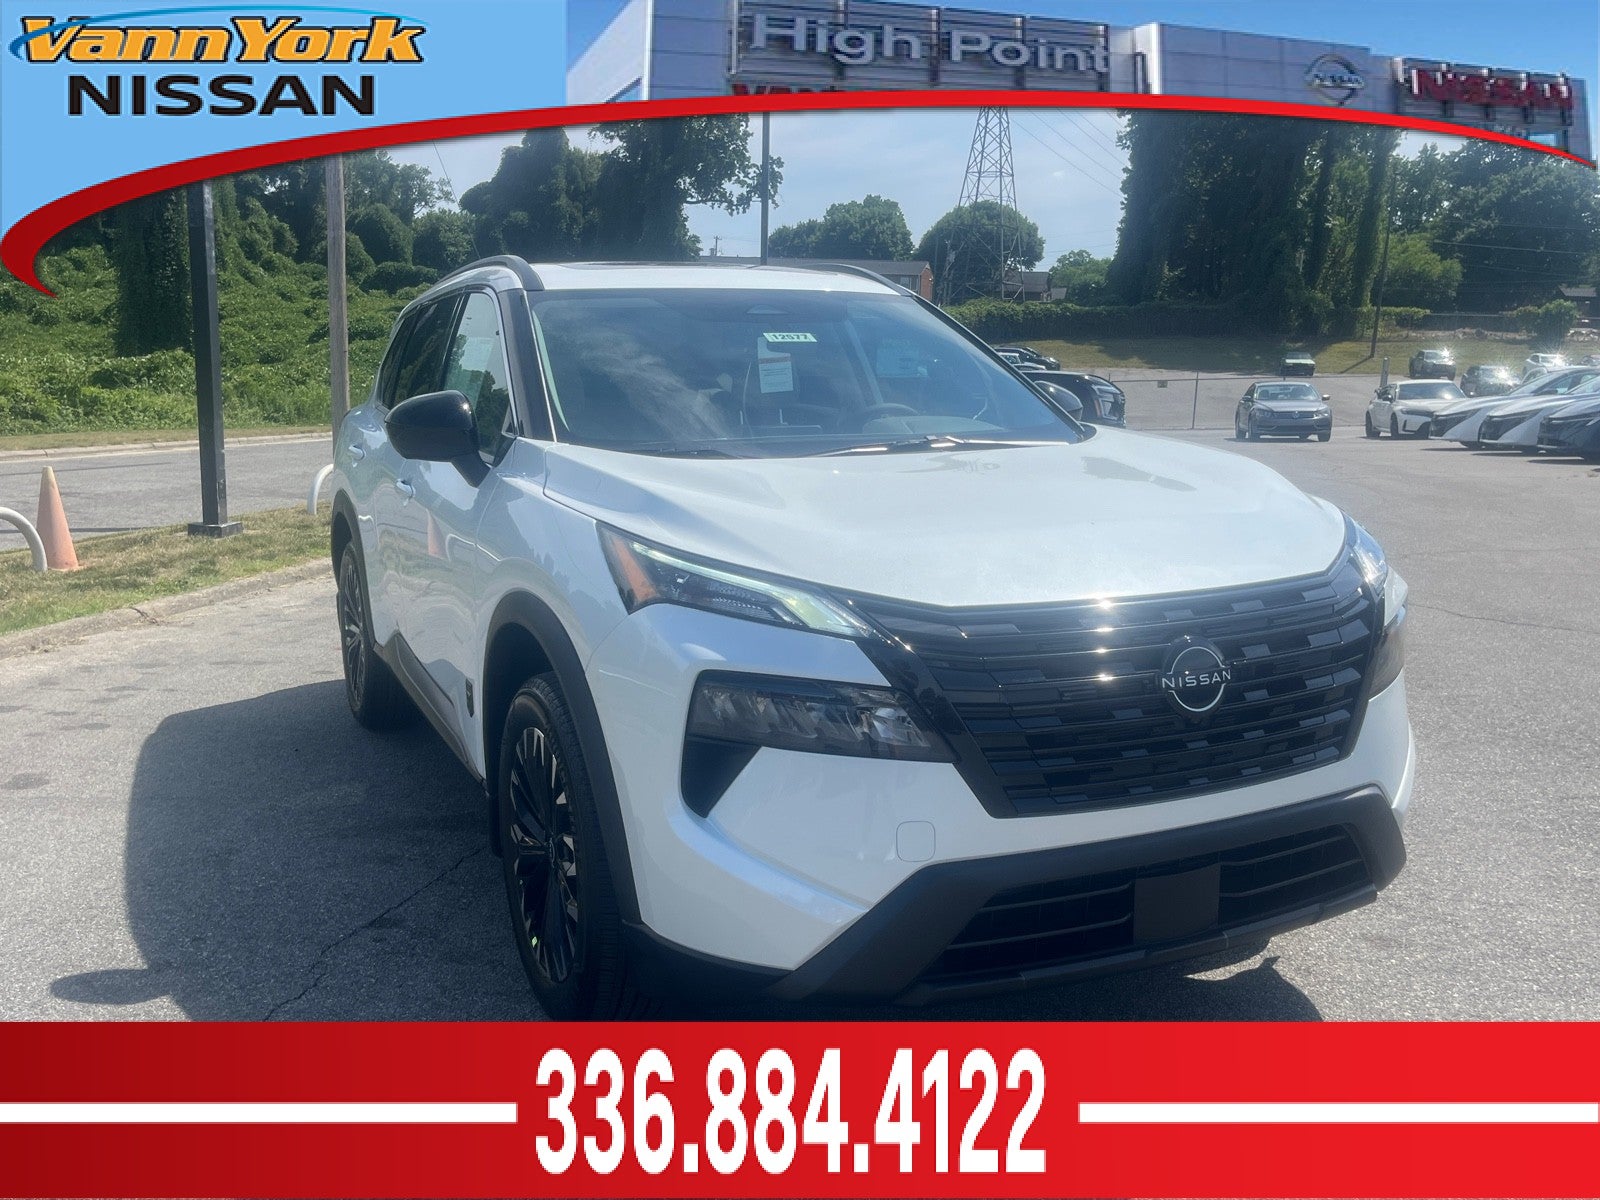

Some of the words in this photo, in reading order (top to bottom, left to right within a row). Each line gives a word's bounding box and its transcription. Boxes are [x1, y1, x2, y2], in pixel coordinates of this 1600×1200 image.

[751, 13, 924, 65] High
[950, 29, 1110, 73] Point
[1161, 669, 1232, 689] NISSAN
